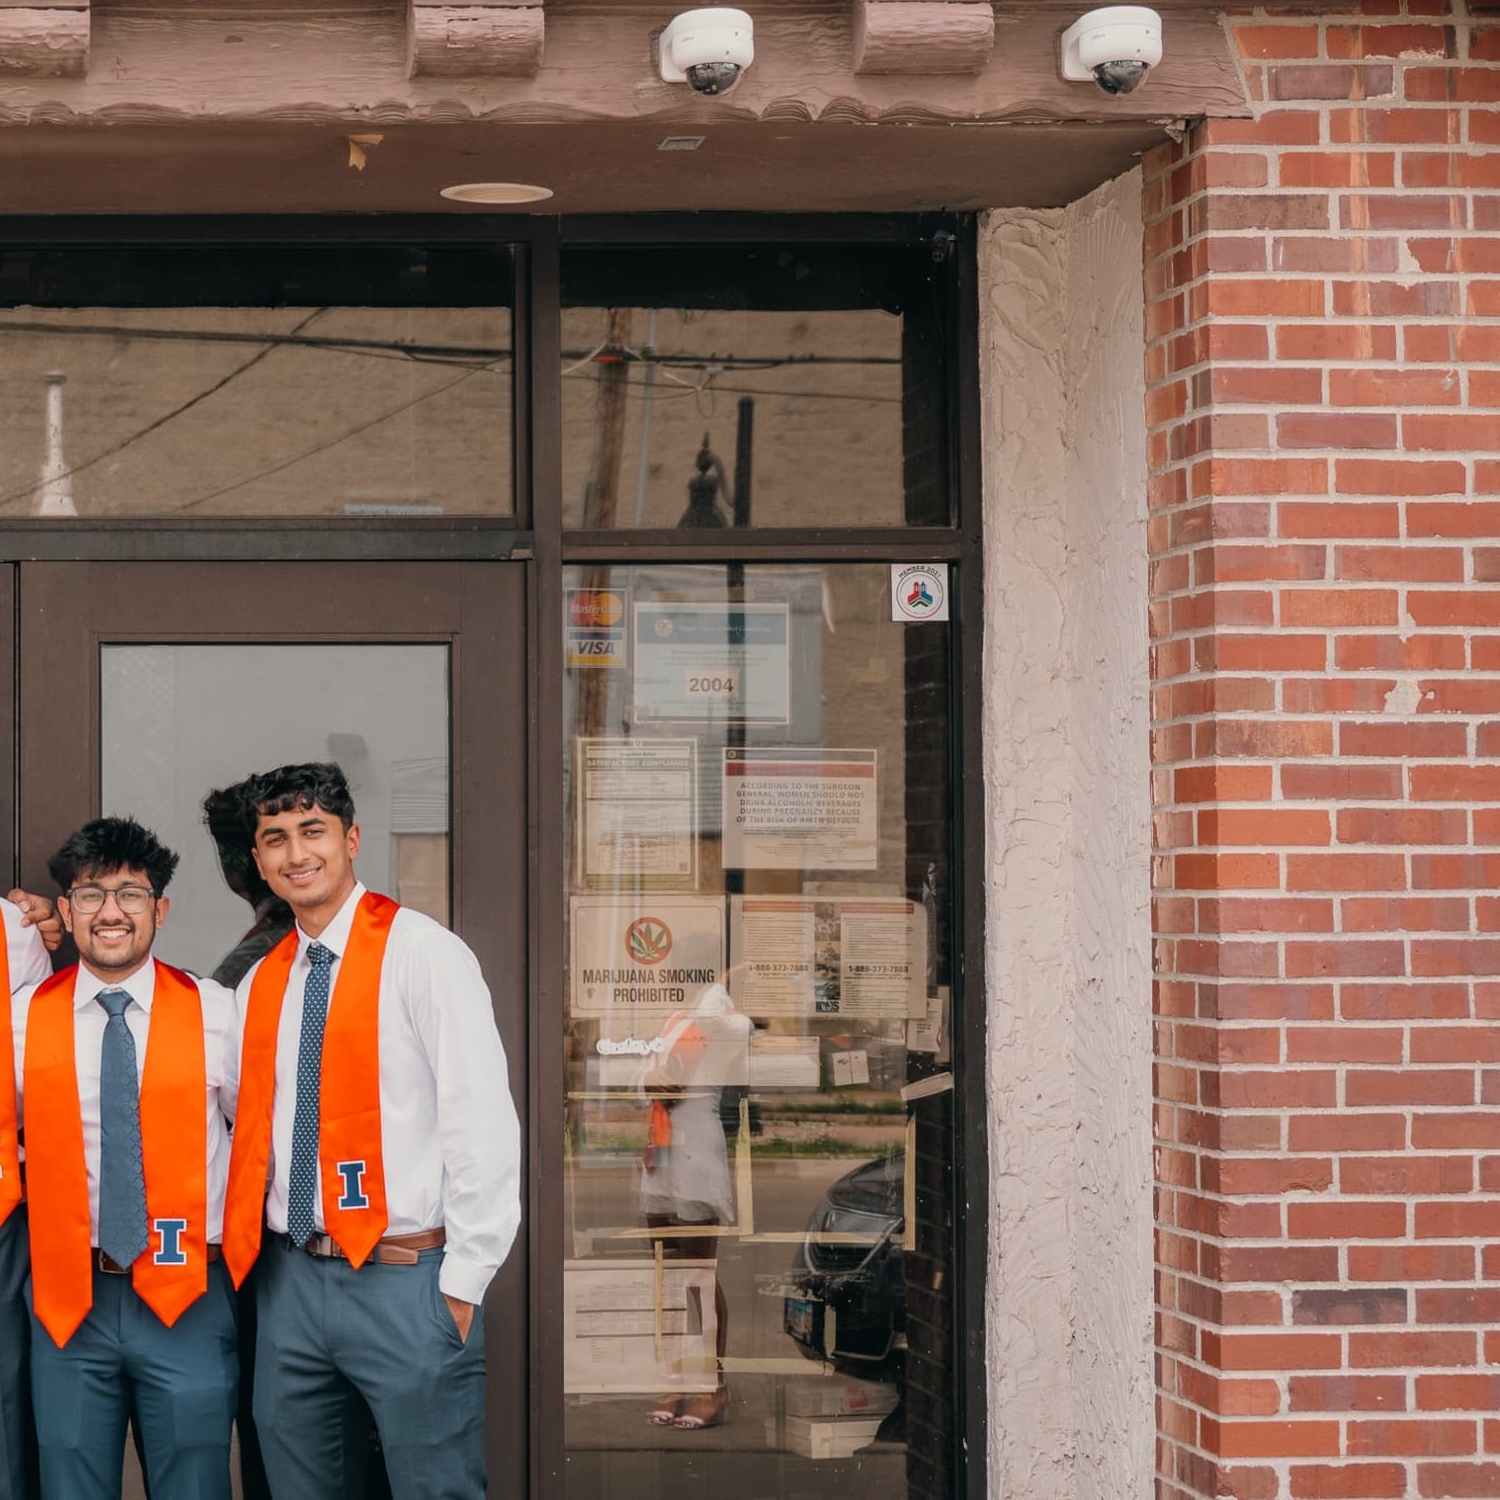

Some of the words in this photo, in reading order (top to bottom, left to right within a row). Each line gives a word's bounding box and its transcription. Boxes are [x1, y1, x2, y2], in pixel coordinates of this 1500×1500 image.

[577, 641, 615, 655] VISA
[689, 677, 734, 693] 2004
[582, 969, 655, 984] MARIJUANA
[658, 969, 715, 984] SMOKING
[613, 988, 685, 1002] PROHIBITED
[336, 1160, 369, 1210] I
[153, 1218, 187, 1265] I
